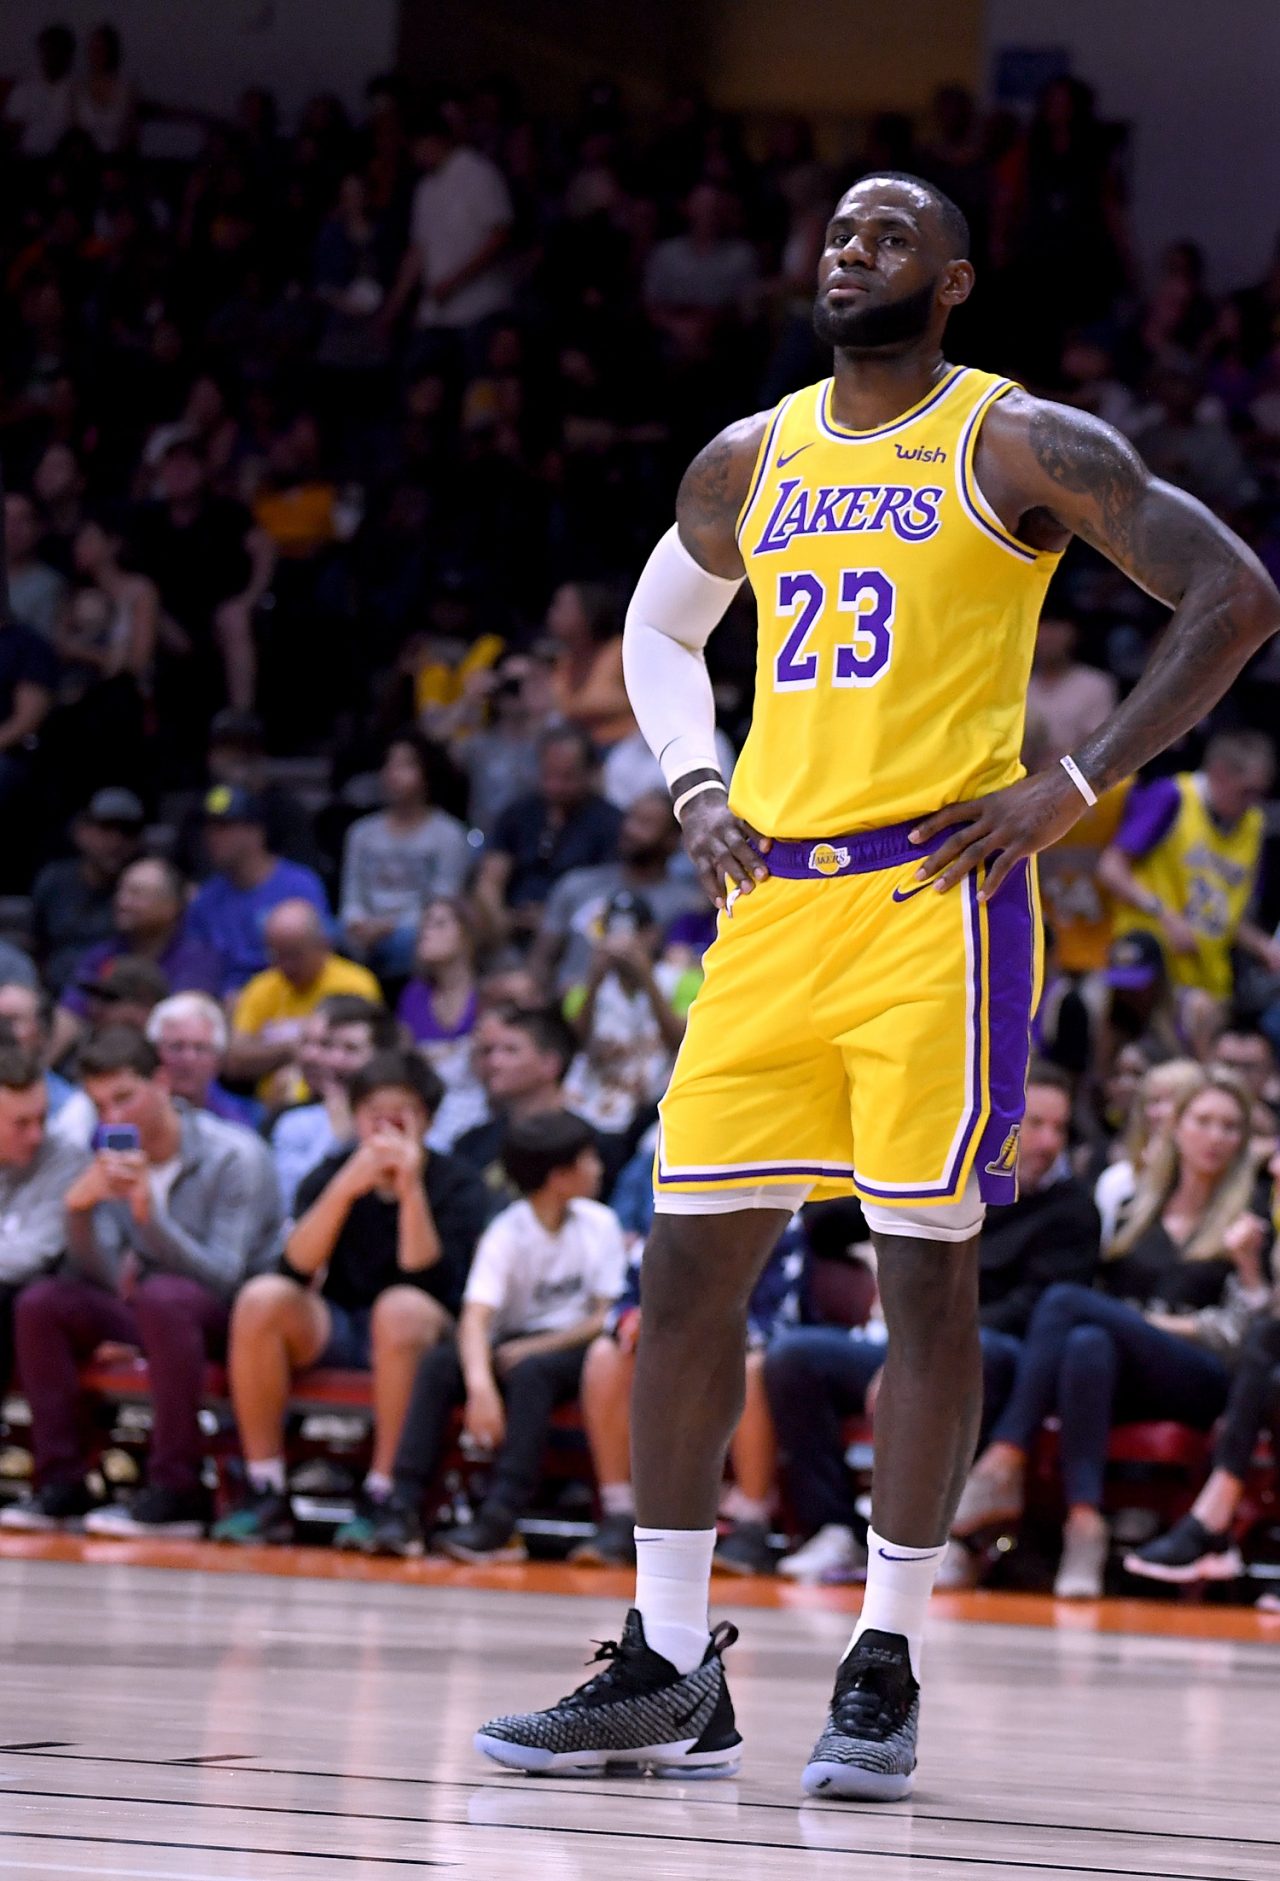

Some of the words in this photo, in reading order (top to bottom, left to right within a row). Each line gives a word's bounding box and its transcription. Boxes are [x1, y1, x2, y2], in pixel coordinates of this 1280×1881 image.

[894, 443, 947, 464] wish
[752, 477, 946, 556] LAKERS
[773, 567, 898, 693] 23
